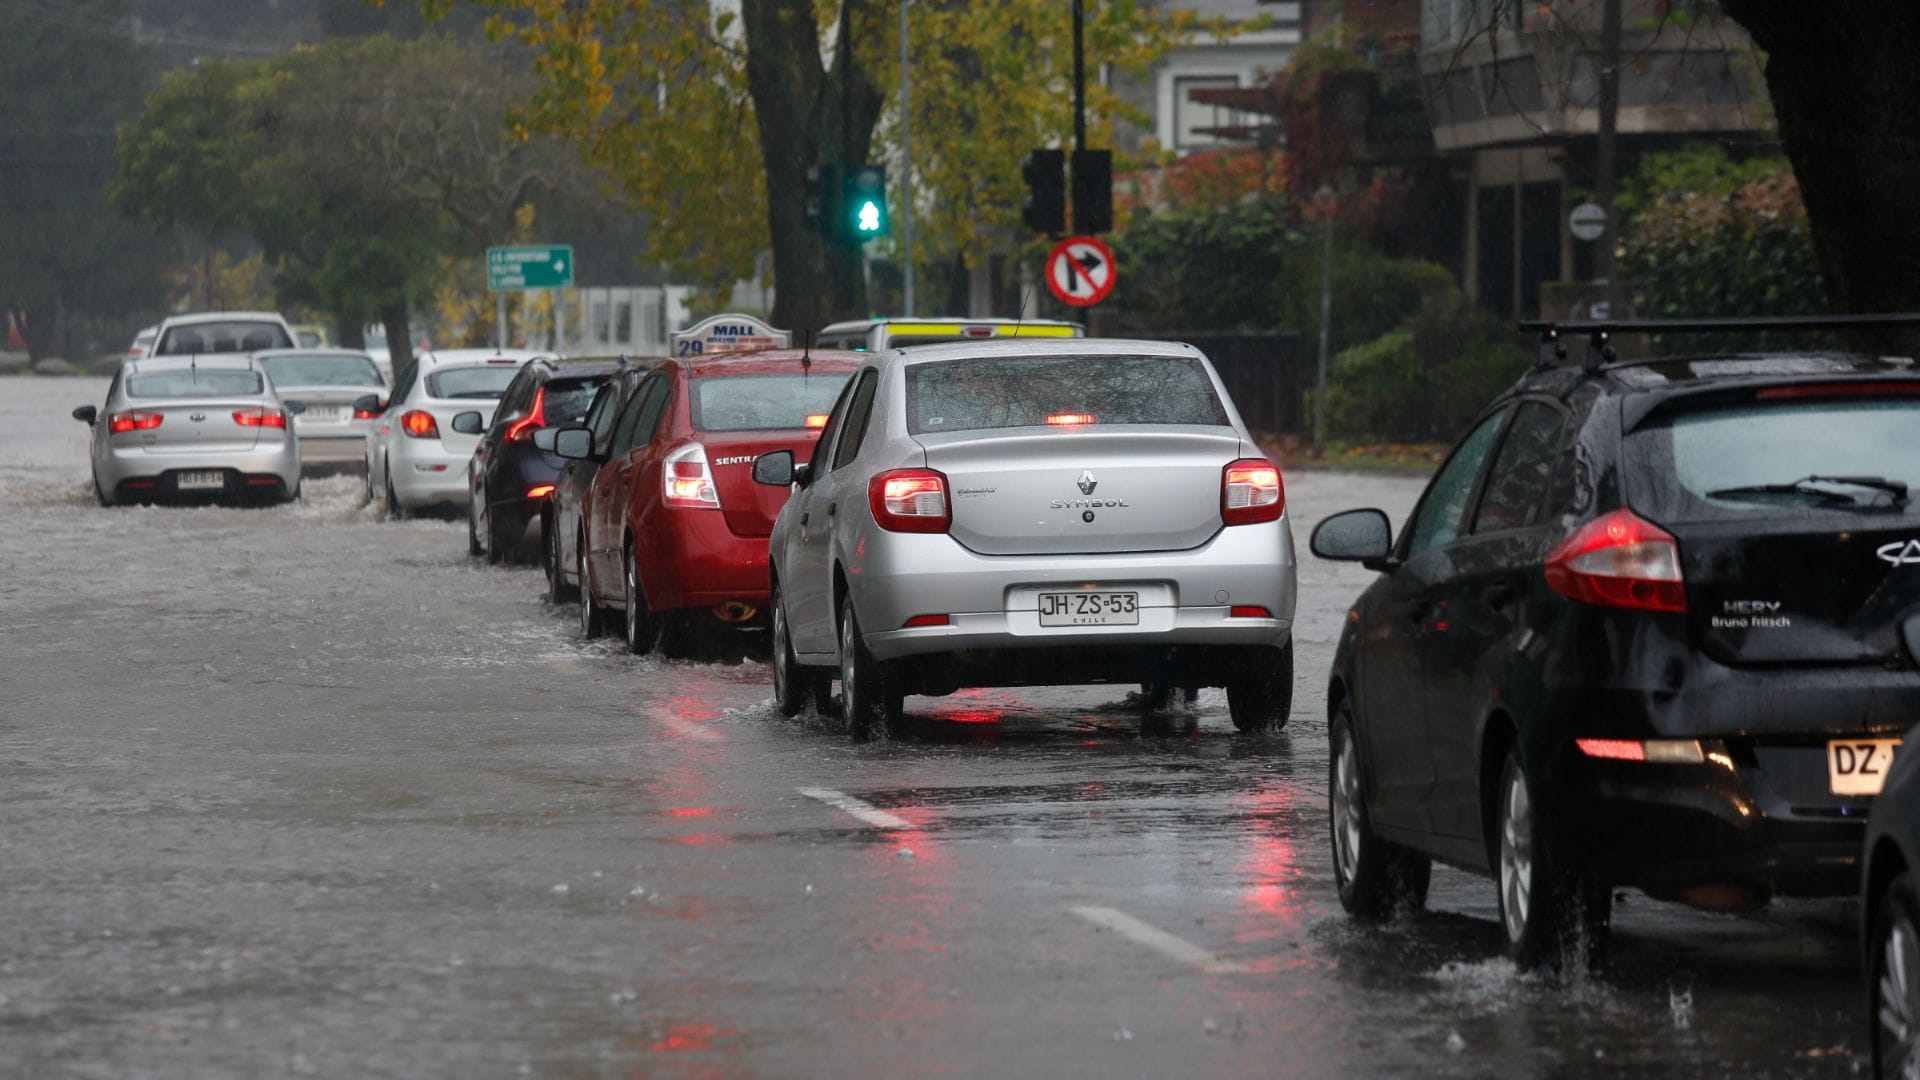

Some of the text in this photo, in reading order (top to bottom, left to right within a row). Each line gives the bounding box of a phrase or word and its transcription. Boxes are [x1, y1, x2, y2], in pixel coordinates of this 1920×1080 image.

[713, 325, 755, 336] MALL
[679, 340, 704, 357] 29
[1050, 498, 1130, 510] SYMBOL
[1711, 615, 1792, 628] Bruno Fritsch
